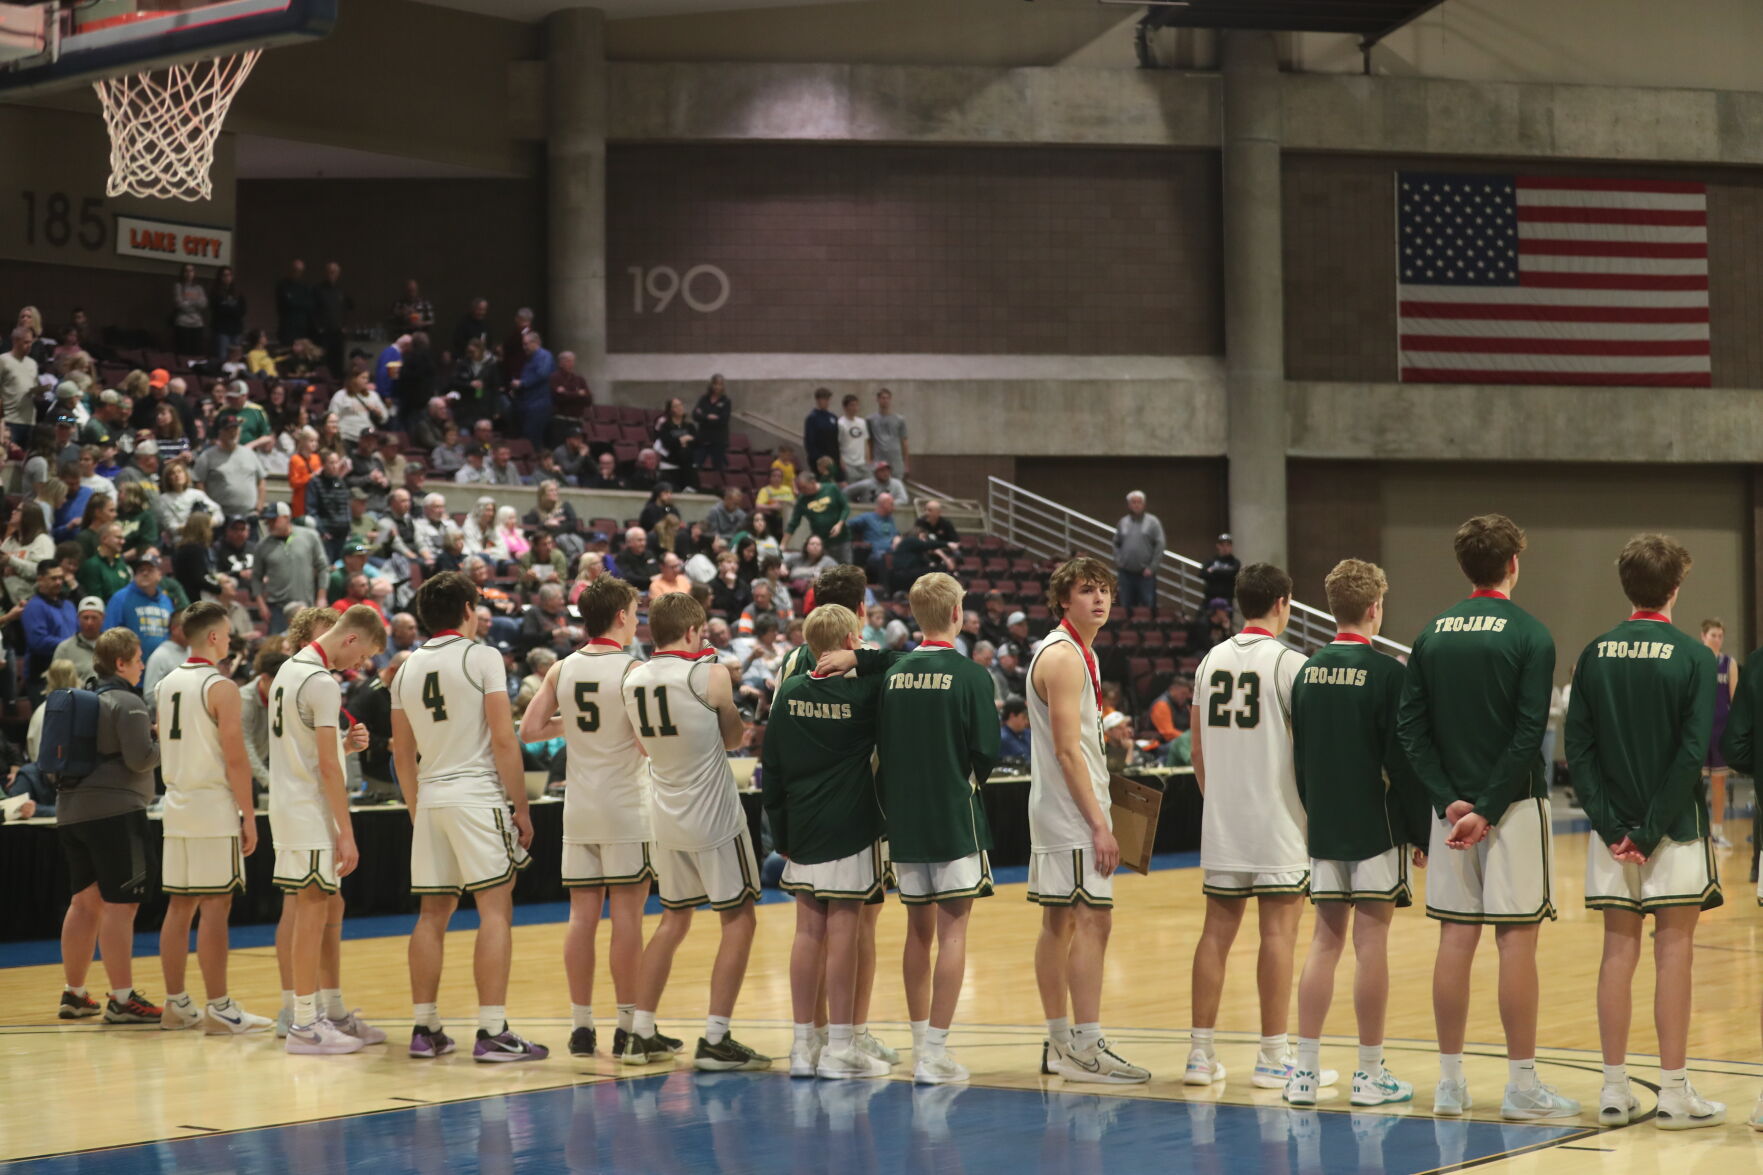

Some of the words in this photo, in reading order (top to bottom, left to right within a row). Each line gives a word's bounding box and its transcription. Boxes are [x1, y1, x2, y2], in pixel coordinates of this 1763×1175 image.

[23, 190, 107, 249] 185
[130, 228, 176, 252] LAKE
[182, 235, 222, 259] CITY
[627, 264, 730, 313] 190
[1435, 615, 1507, 633] TROJANS
[1597, 641, 1674, 660] TROJANS
[421, 670, 448, 723] 4
[889, 672, 953, 690] TROJANS
[1208, 669, 1260, 730] 23
[1303, 666, 1368, 687] TROJANS
[169, 691, 182, 740] 1
[272, 685, 284, 738] 3
[574, 681, 600, 733] 5
[633, 684, 680, 738] 11
[788, 699, 852, 720] TROJANS
